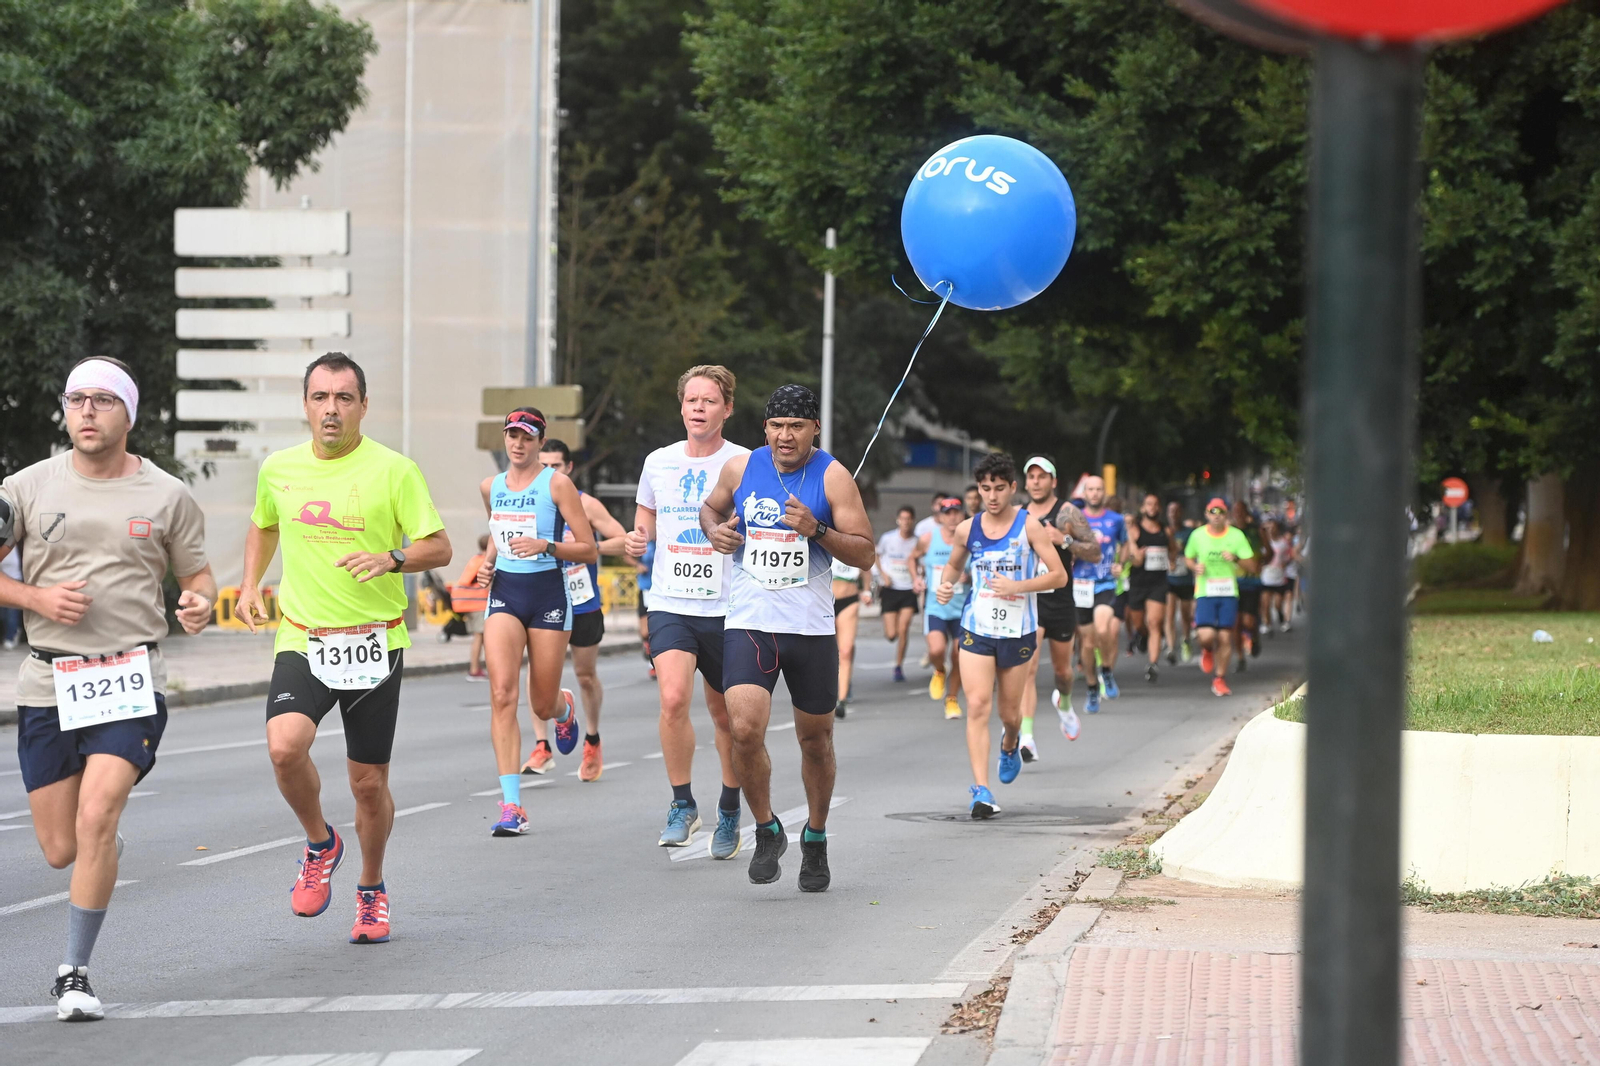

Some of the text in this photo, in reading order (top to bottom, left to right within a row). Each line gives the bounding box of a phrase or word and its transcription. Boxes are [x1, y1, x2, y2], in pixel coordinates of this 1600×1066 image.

[495, 495, 536, 508] nerja
[753, 511, 779, 522] run
[750, 549, 804, 567] 11975
[674, 562, 713, 578] 6026
[991, 608, 1007, 621] 39
[308, 627, 328, 636] 42
[316, 645, 383, 665] 13106
[55, 660, 78, 673] 42
[66, 673, 145, 702] 13219
